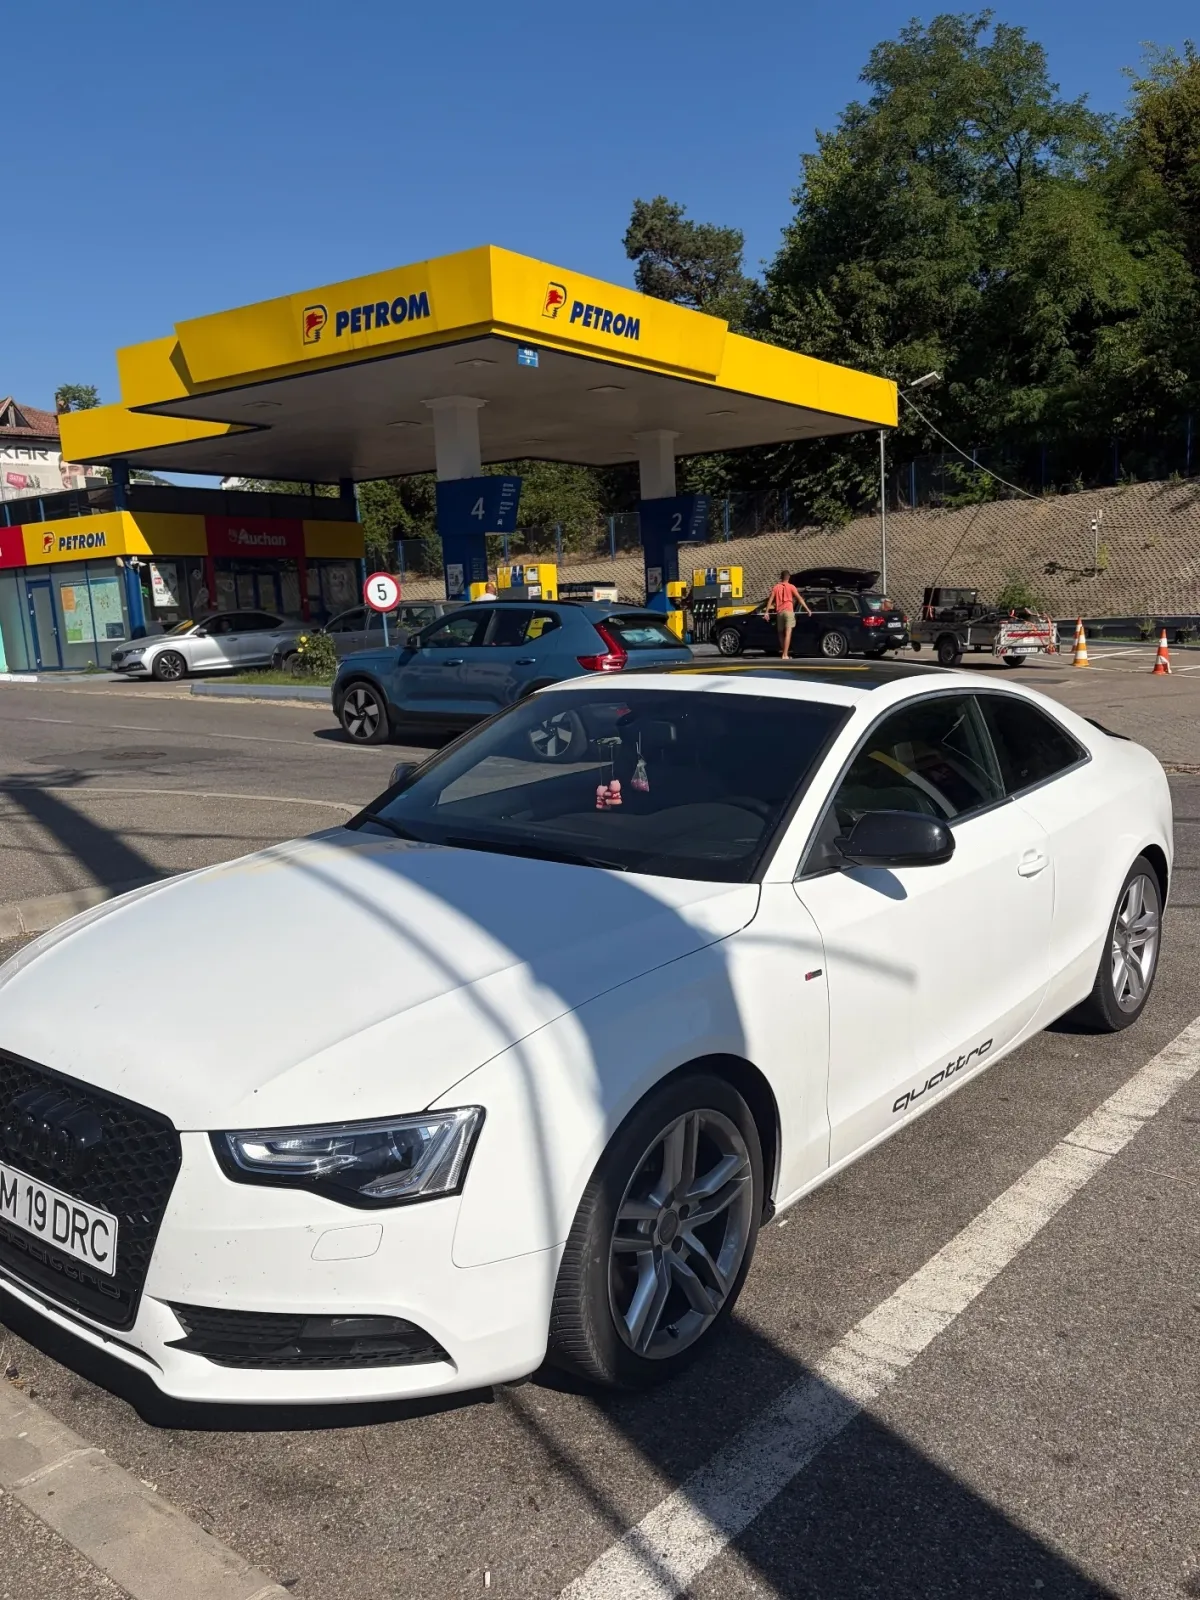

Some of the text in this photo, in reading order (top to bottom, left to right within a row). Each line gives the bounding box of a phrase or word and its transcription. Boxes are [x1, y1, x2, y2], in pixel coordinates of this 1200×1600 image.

[336, 292, 431, 337] PETROM
[569, 301, 640, 341] PETROM
[470, 496, 486, 521] 4
[671, 512, 682, 532] 2
[58, 532, 106, 552] PETROM
[238, 528, 287, 546] Auchan
[377, 583, 387, 602] 5
[892, 1038, 994, 1113] quattro
[26, 1184, 47, 1232] 19
[52, 1197, 109, 1262] DRC
